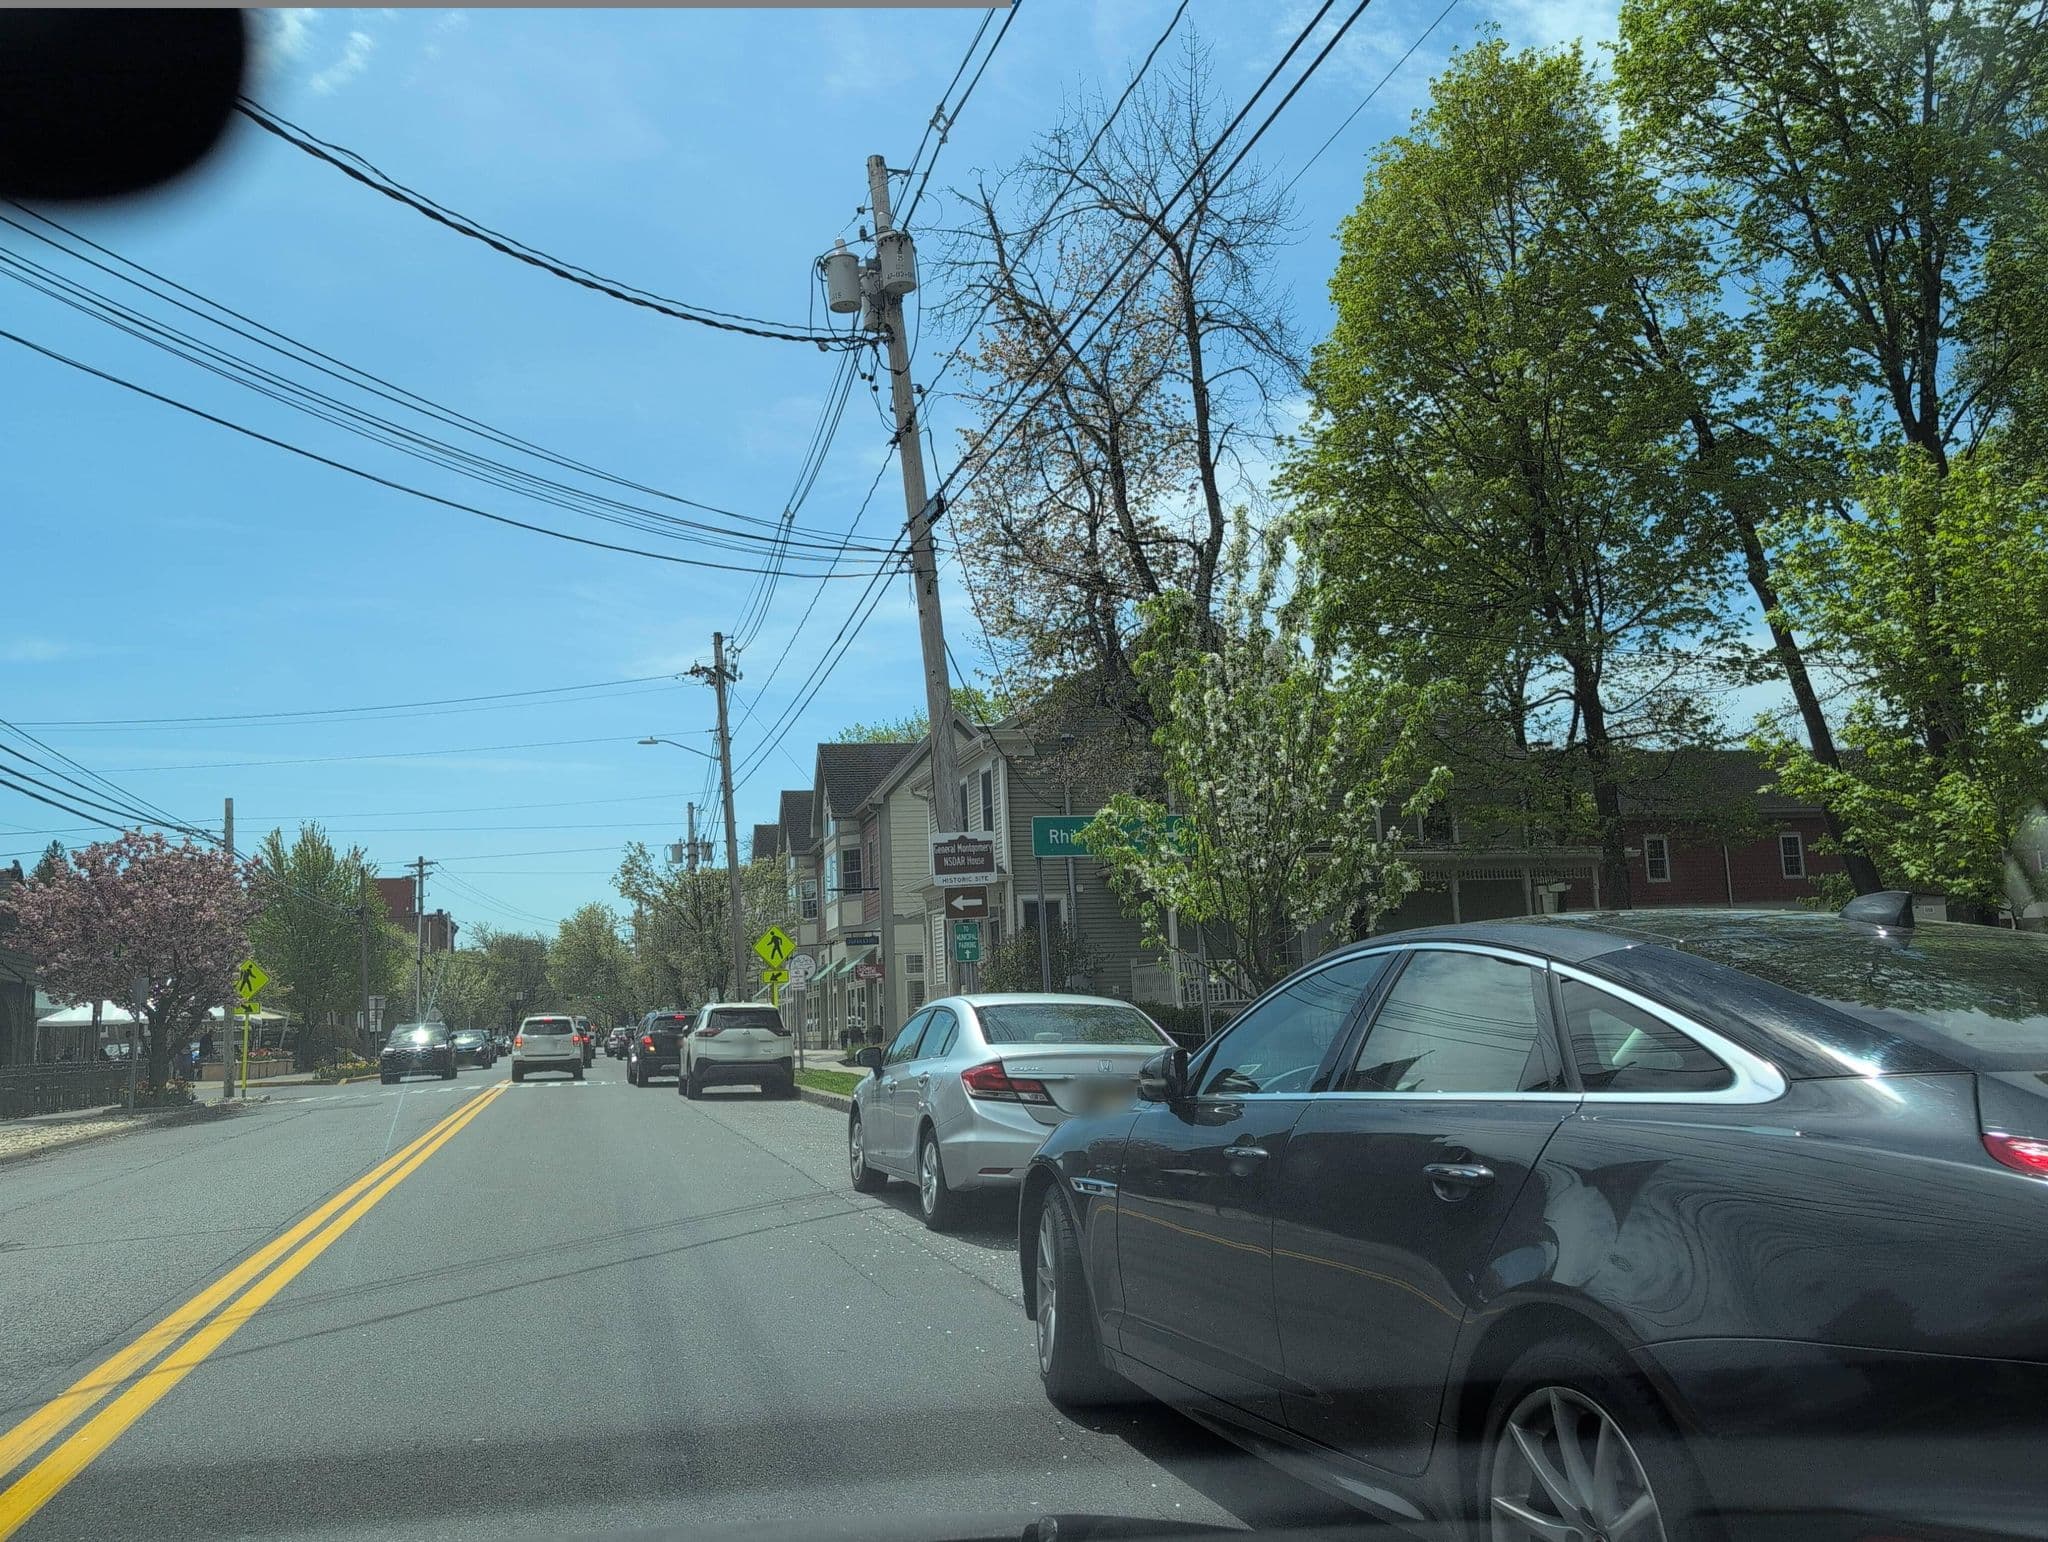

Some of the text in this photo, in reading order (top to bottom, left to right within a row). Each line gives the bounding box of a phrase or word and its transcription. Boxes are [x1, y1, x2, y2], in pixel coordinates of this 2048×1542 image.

[934, 843, 993, 855] General Montgomery
[944, 855, 985, 866] NSDAR House
